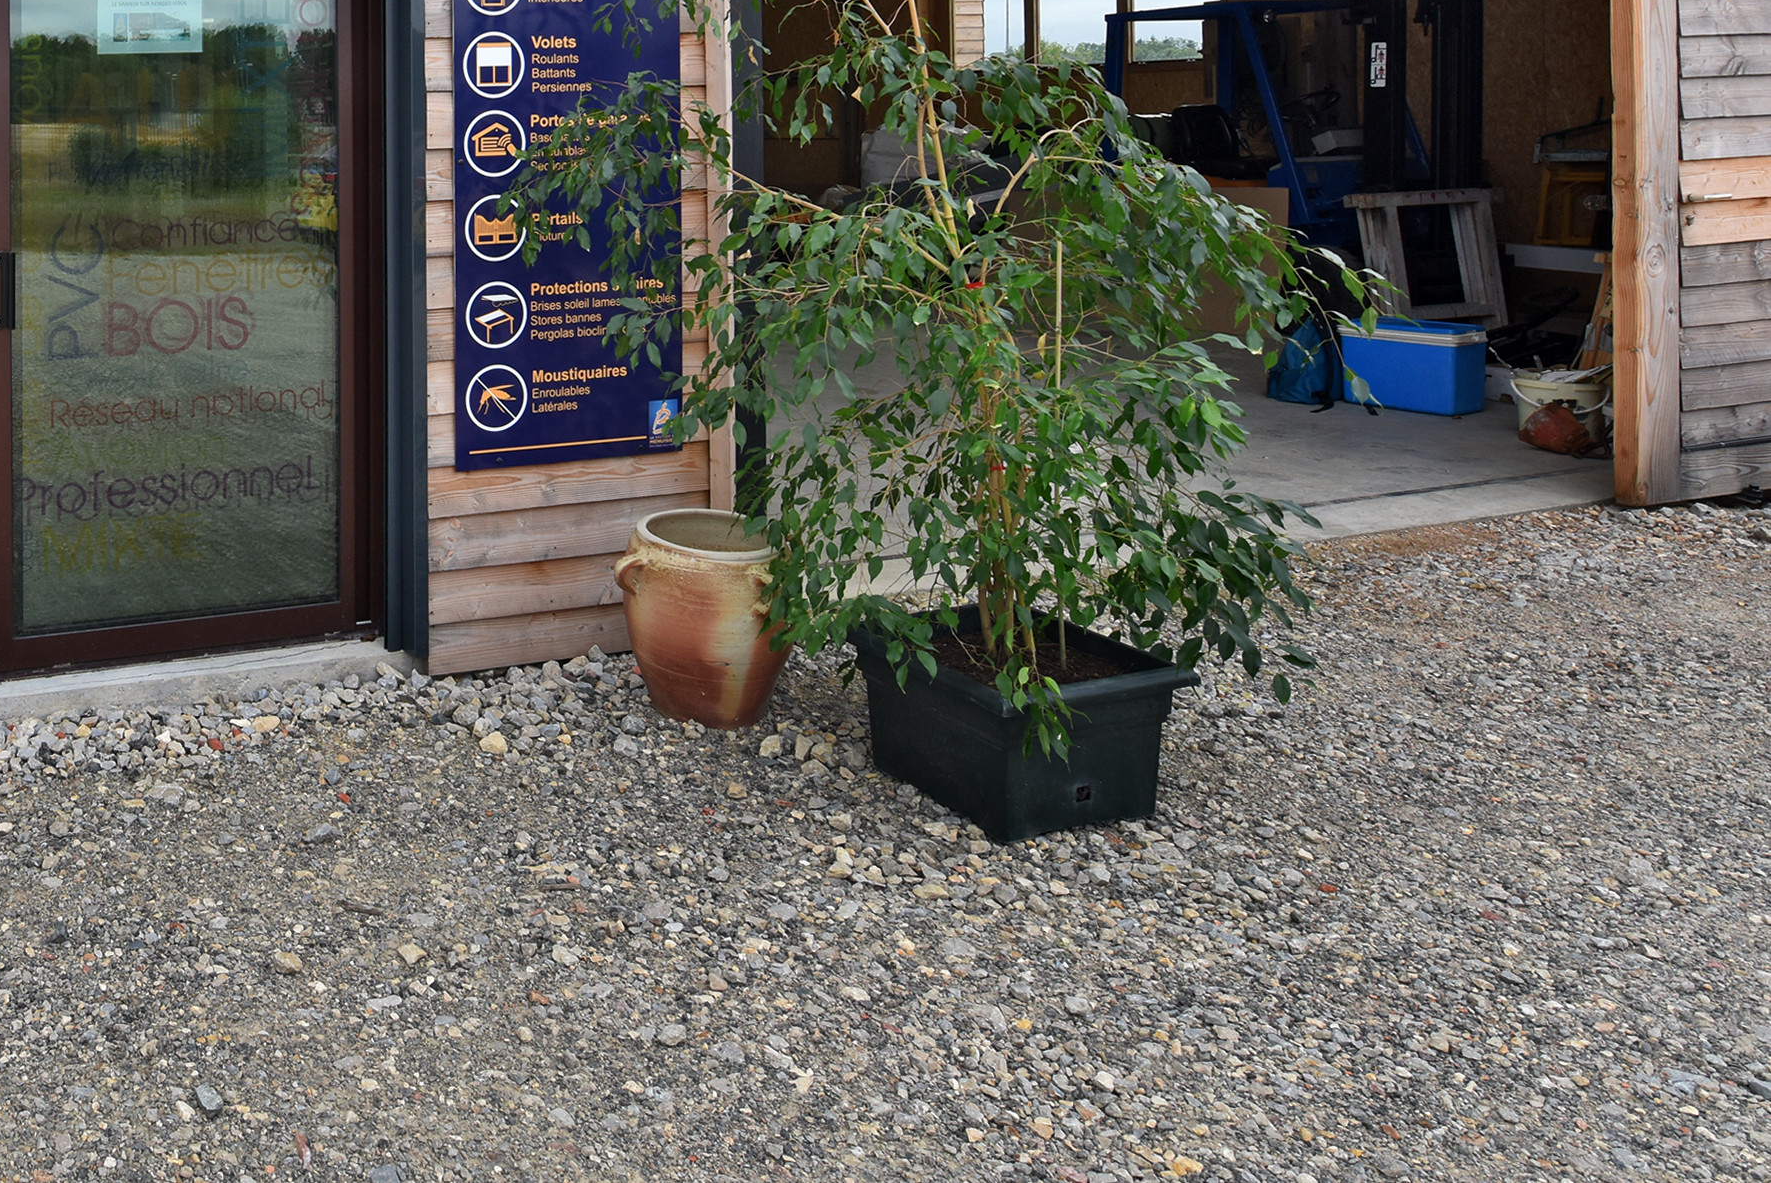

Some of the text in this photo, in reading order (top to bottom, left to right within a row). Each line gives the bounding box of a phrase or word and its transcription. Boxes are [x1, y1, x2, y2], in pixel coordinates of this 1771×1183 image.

[531, 36, 576, 49] Volets
[532, 53, 579, 65] Roulants
[532, 67, 576, 79] Battants
[532, 81, 592, 93] Persiennes
[532, 212, 583, 225] Prtails
[114, 216, 300, 251] Confiance
[47, 221, 104, 361] PVC
[530, 280, 608, 296] Protections
[530, 300, 562, 312] Brises
[564, 298, 589, 310] soleil
[592, 297, 621, 308] lames
[106, 296, 251, 357] BOIS
[530, 313, 602, 326] Stores bannes
[530, 328, 574, 342] Pergolas
[532, 364, 628, 383] Moustiquaires
[532, 384, 591, 399] Enroulables
[532, 399, 578, 413] Latérales
[12, 454, 314, 516] Professionnel
